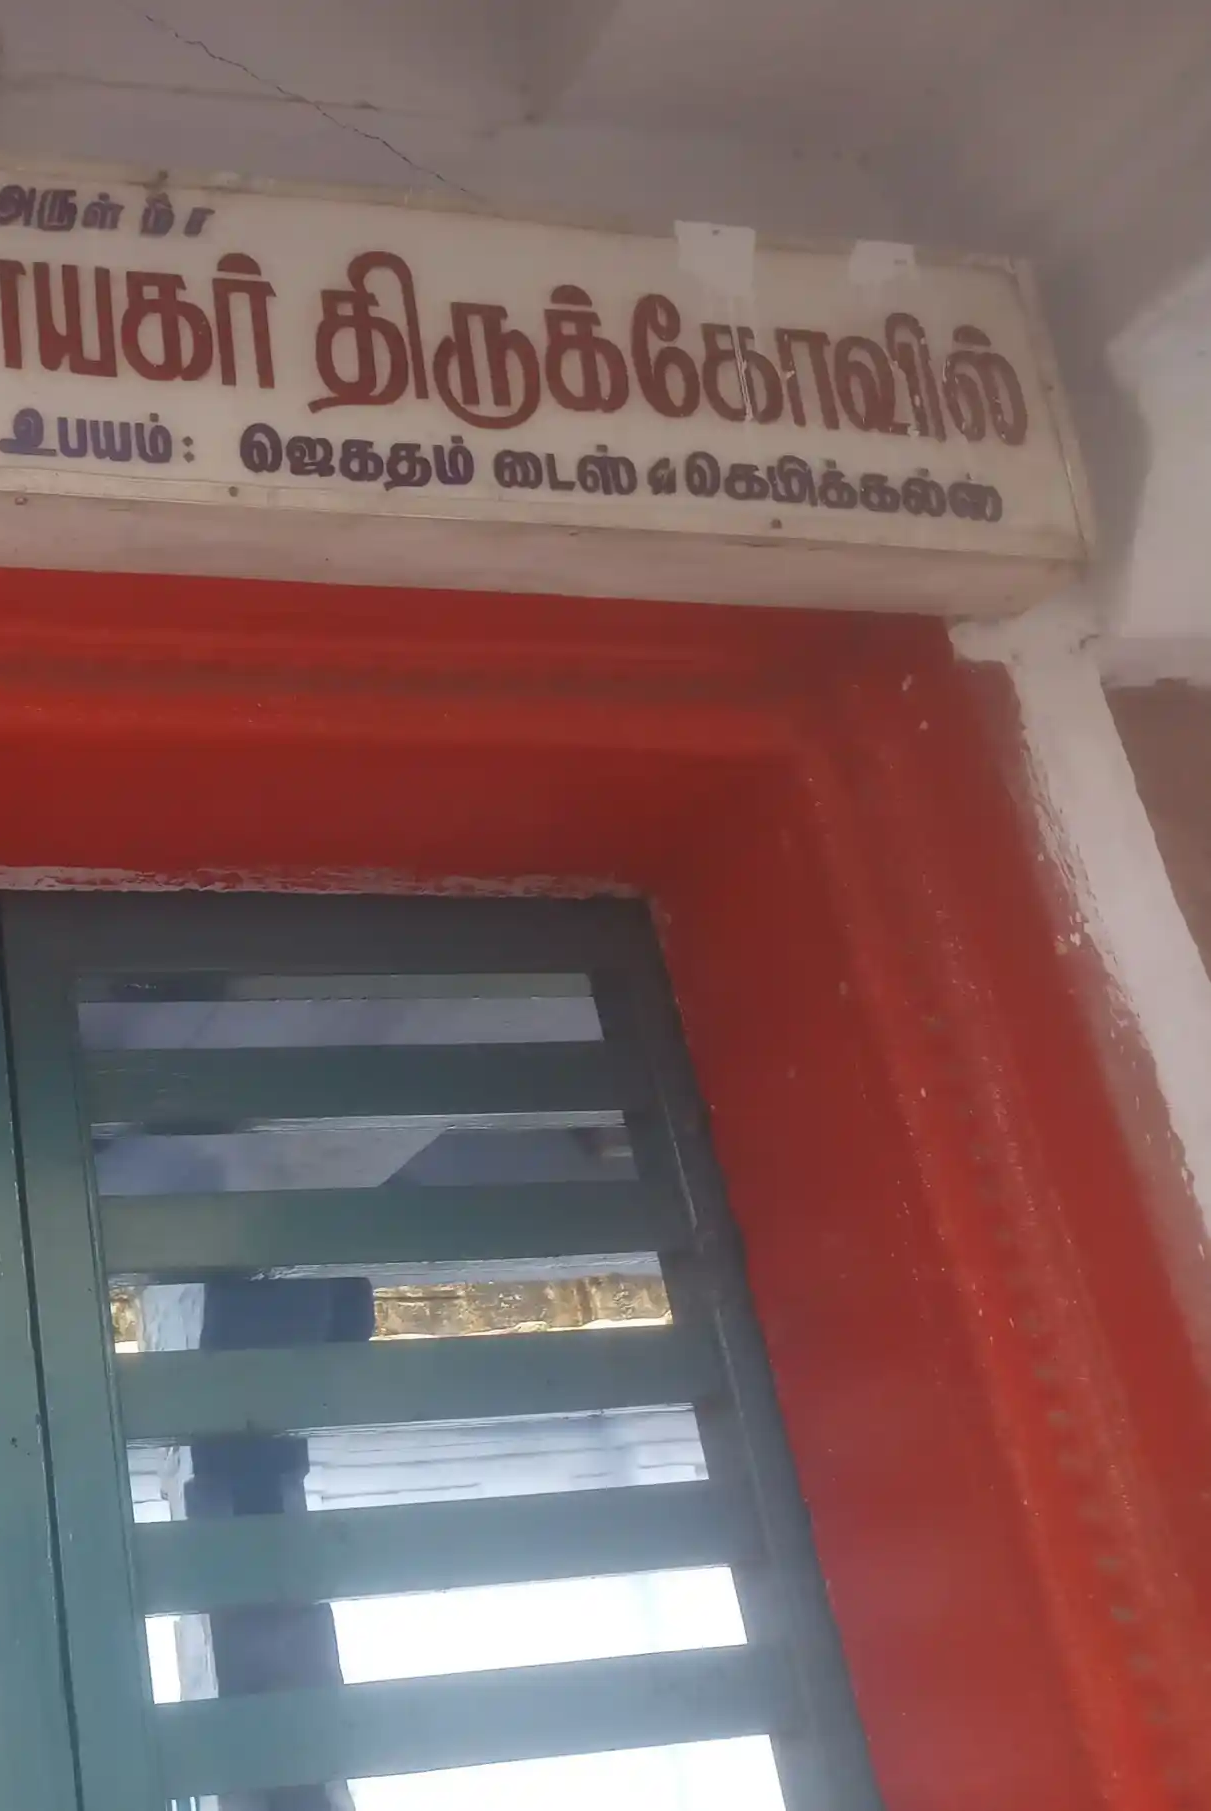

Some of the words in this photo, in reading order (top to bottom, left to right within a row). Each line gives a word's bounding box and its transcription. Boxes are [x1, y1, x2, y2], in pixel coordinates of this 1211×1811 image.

[307, 250, 1029, 446] திருக்கோவில்
[239, 422, 475, 491] ஜெகதம்
[493, 444, 638, 496] டைஸ்
